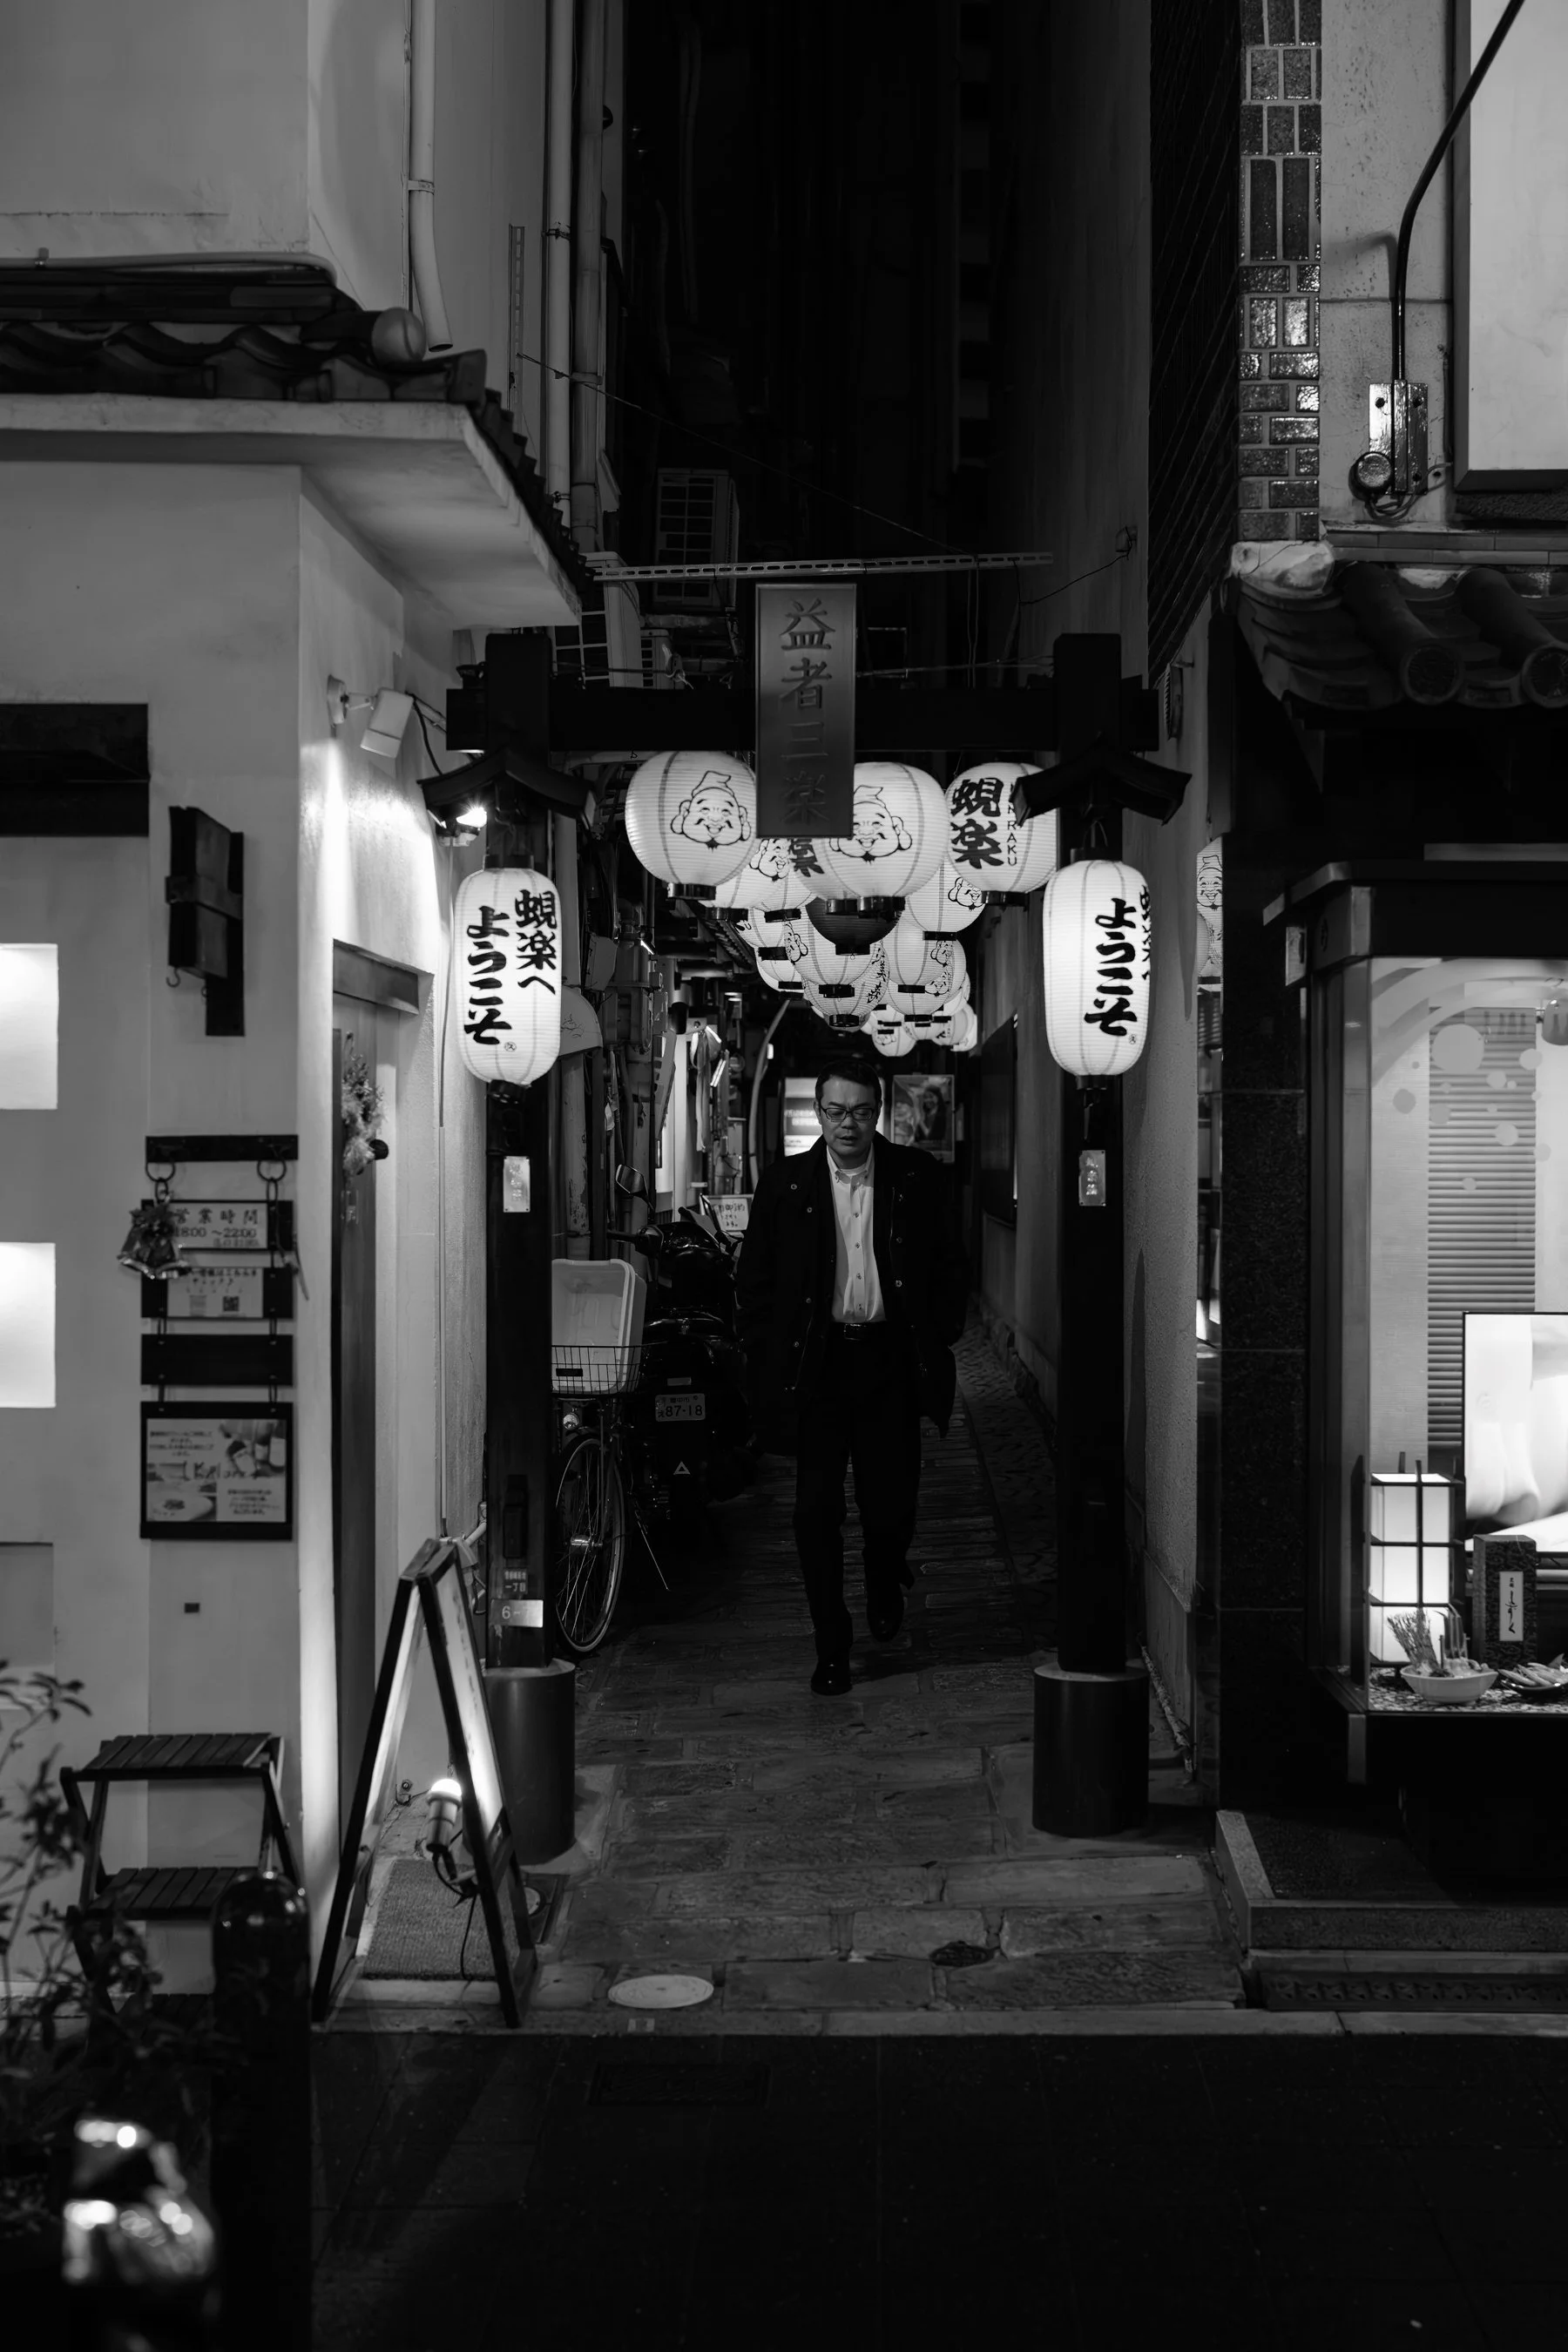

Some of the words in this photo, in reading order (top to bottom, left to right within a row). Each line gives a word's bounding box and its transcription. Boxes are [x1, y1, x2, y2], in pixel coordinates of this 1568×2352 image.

[463, 905, 511, 1045] ようこそ
[1085, 897, 1137, 1036] ようこそ
[666, 1404, 702, 1417] 87-18
